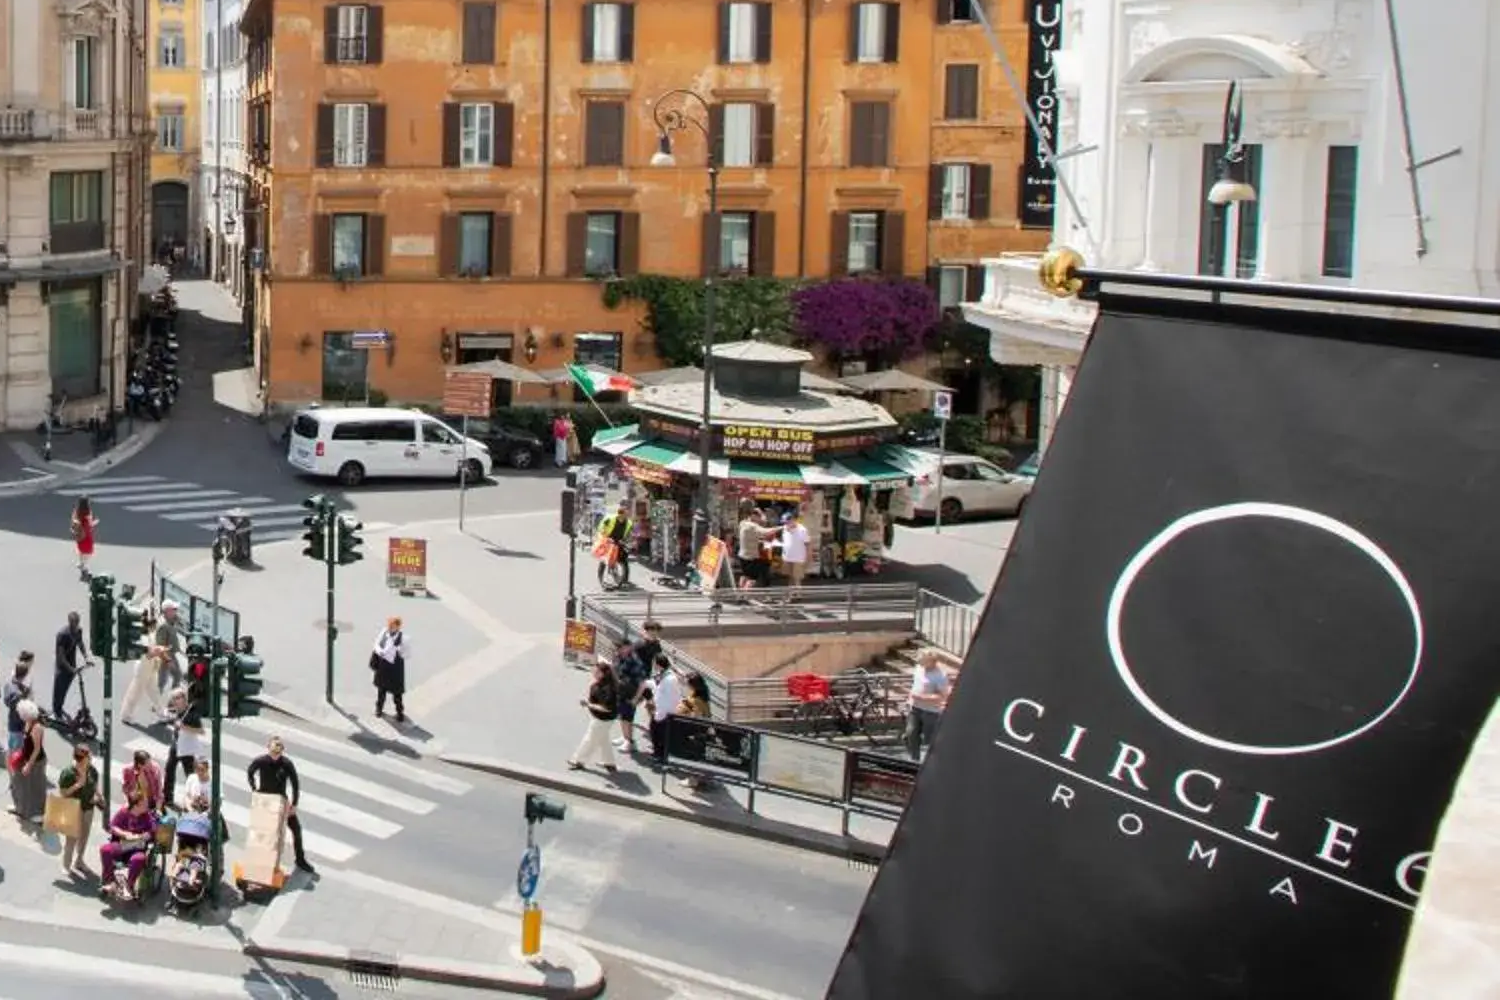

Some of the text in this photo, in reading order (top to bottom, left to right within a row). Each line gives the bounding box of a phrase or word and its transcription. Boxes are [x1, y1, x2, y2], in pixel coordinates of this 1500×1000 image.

[724, 425, 813, 440] OPEN BUS
[723, 437, 746, 448] HOP
[748, 439, 764, 450] ON
[767, 440, 790, 451] HOP
[792, 442, 813, 453] OFF
[1052, 783, 1298, 905] ROMA
